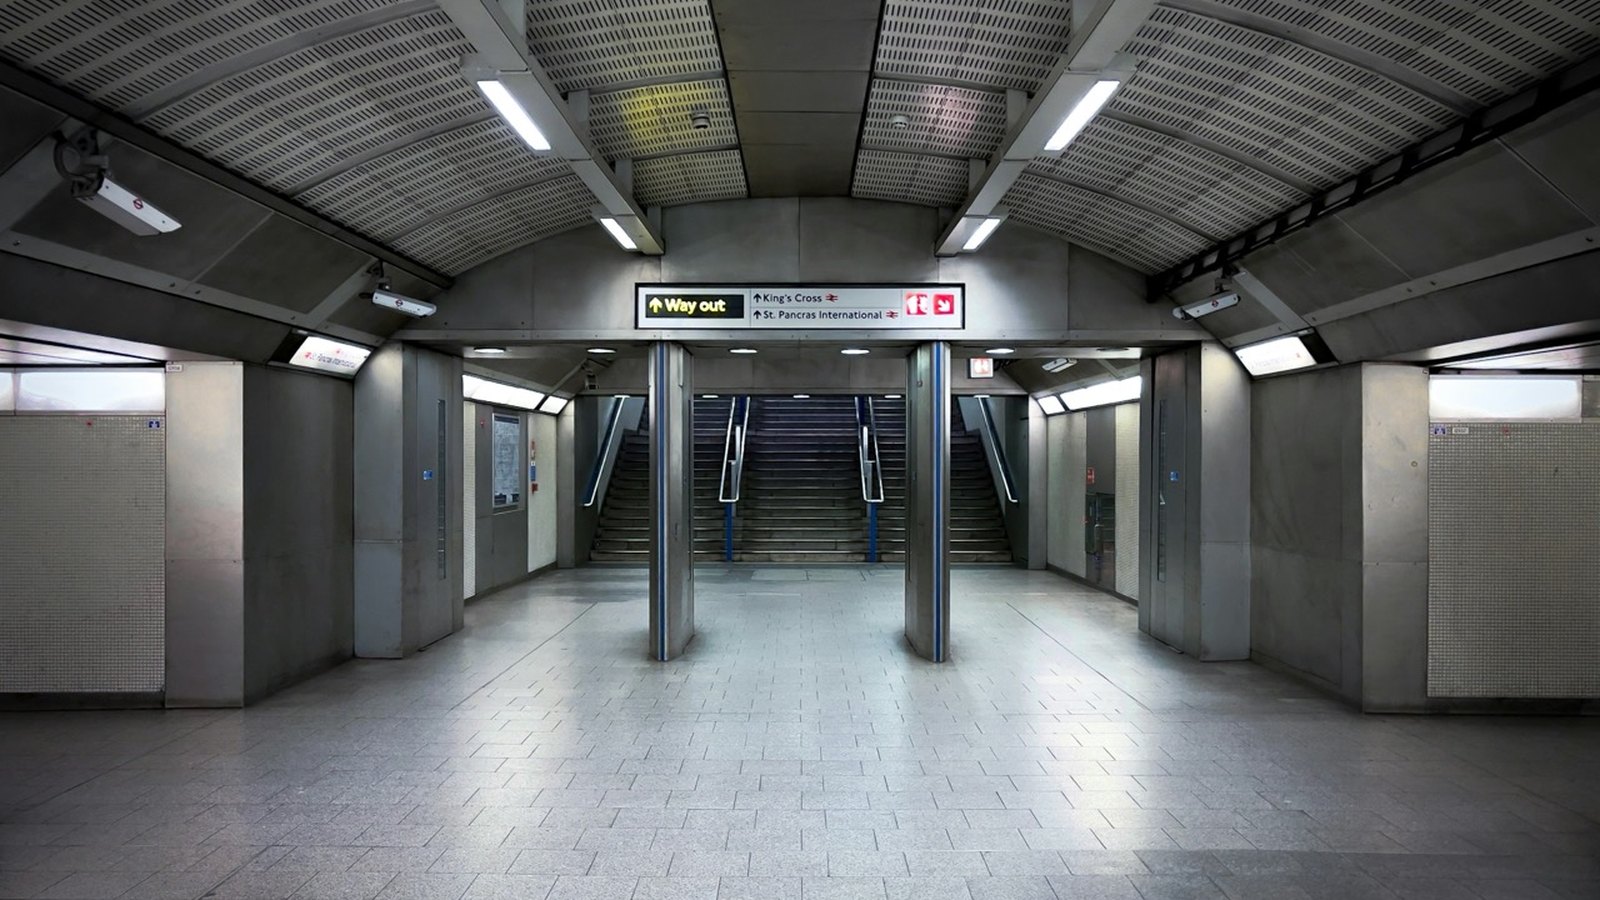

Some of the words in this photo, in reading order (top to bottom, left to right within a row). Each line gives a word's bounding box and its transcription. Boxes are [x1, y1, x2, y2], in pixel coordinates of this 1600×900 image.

[763, 293, 792, 304] King's
[794, 293, 822, 302] Cross
[664, 298, 697, 315] Way
[699, 299, 726, 312] out
[763, 310, 776, 319] St.
[779, 310, 816, 319] Pancras
[819, 310, 883, 319] International
